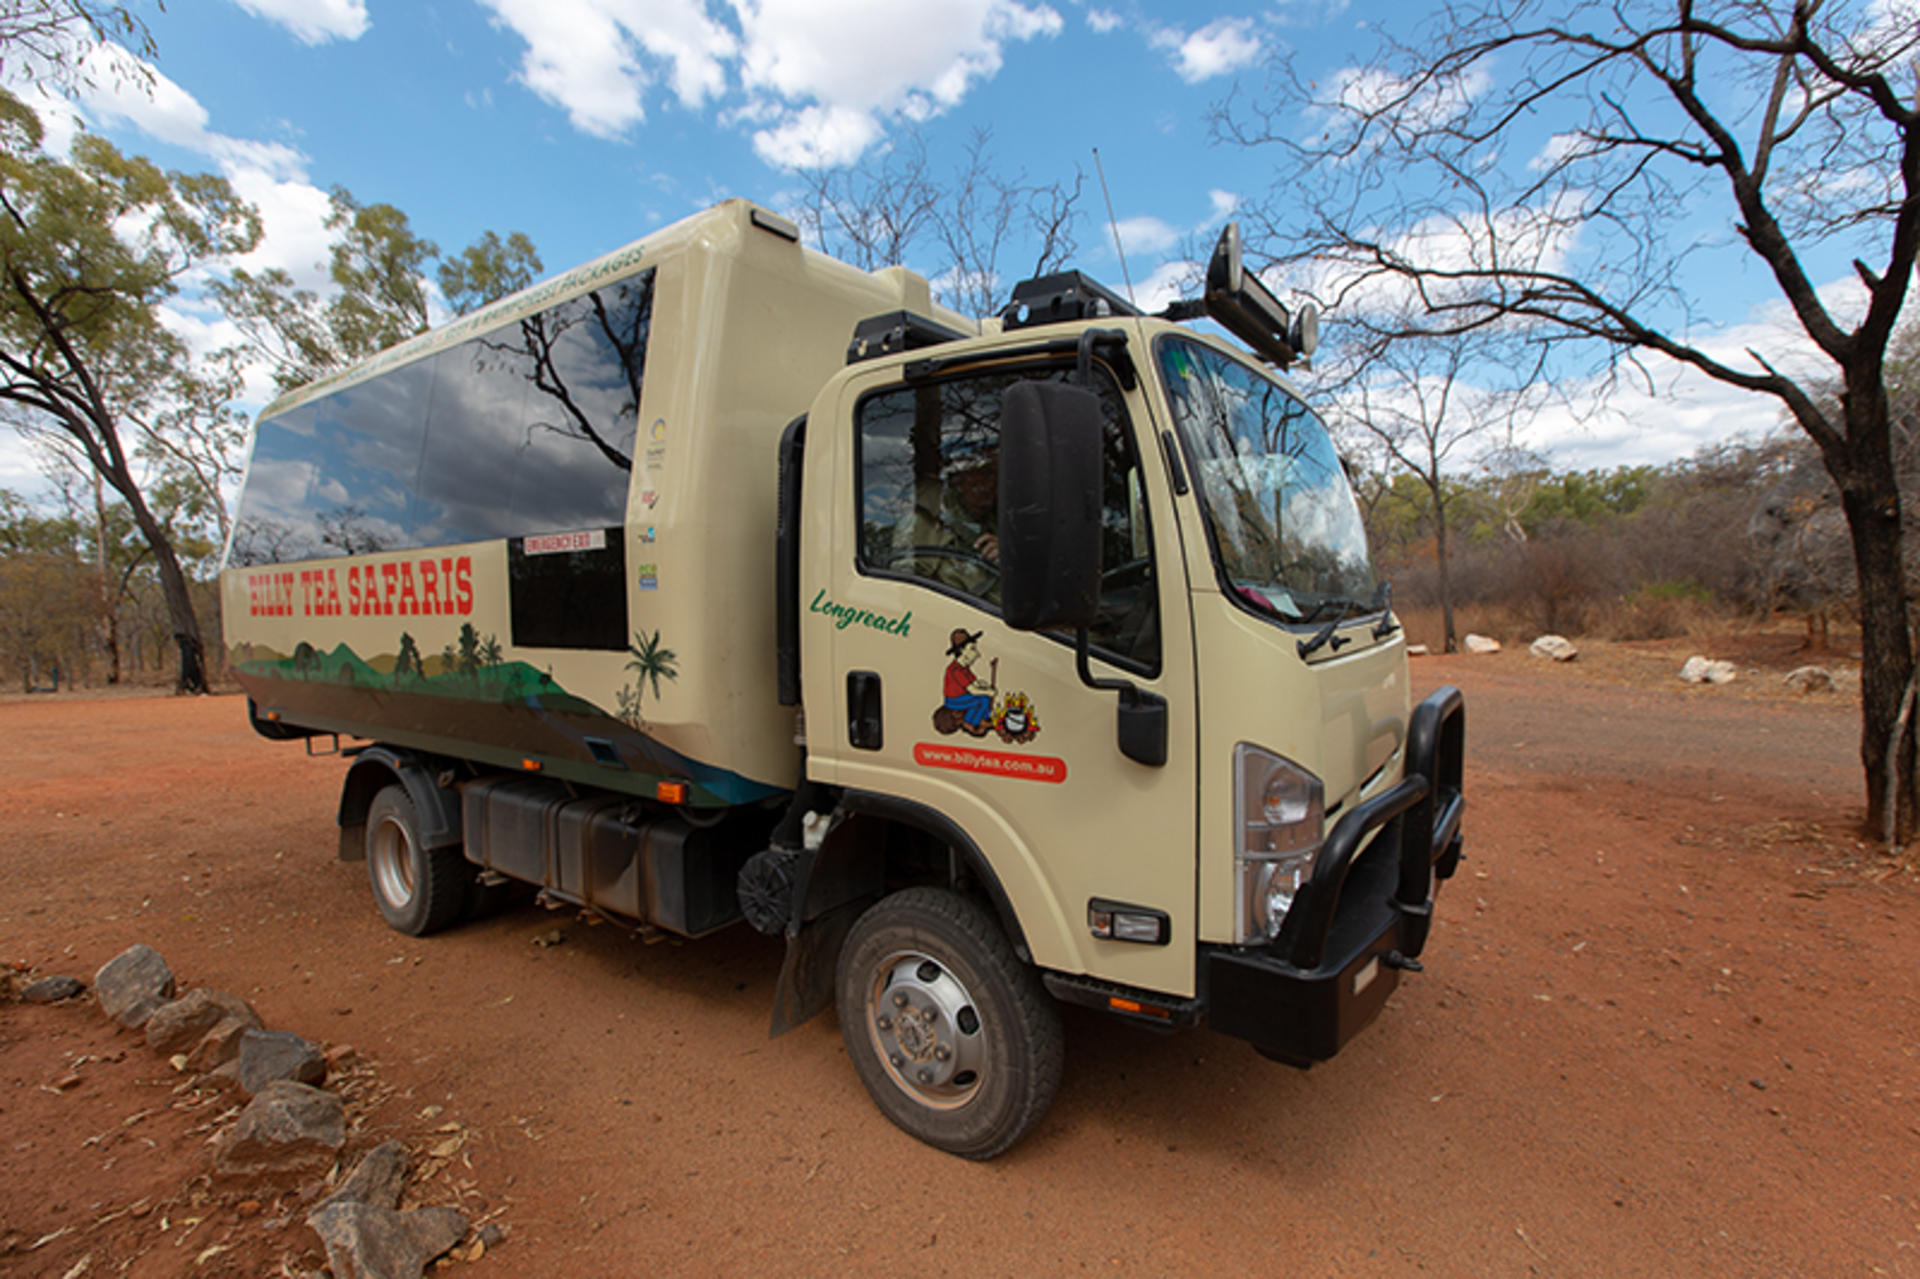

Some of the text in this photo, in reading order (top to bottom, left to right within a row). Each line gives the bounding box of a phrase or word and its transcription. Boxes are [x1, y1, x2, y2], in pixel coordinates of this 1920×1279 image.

[559, 244, 645, 293] PACKAGES
[525, 534, 572, 554] EMERGENCY
[249, 556, 474, 616] BILLY TEA SAFARIS
[809, 588, 913, 637] Longreach
[922, 749, 1055, 776] www.billytea.com.au
